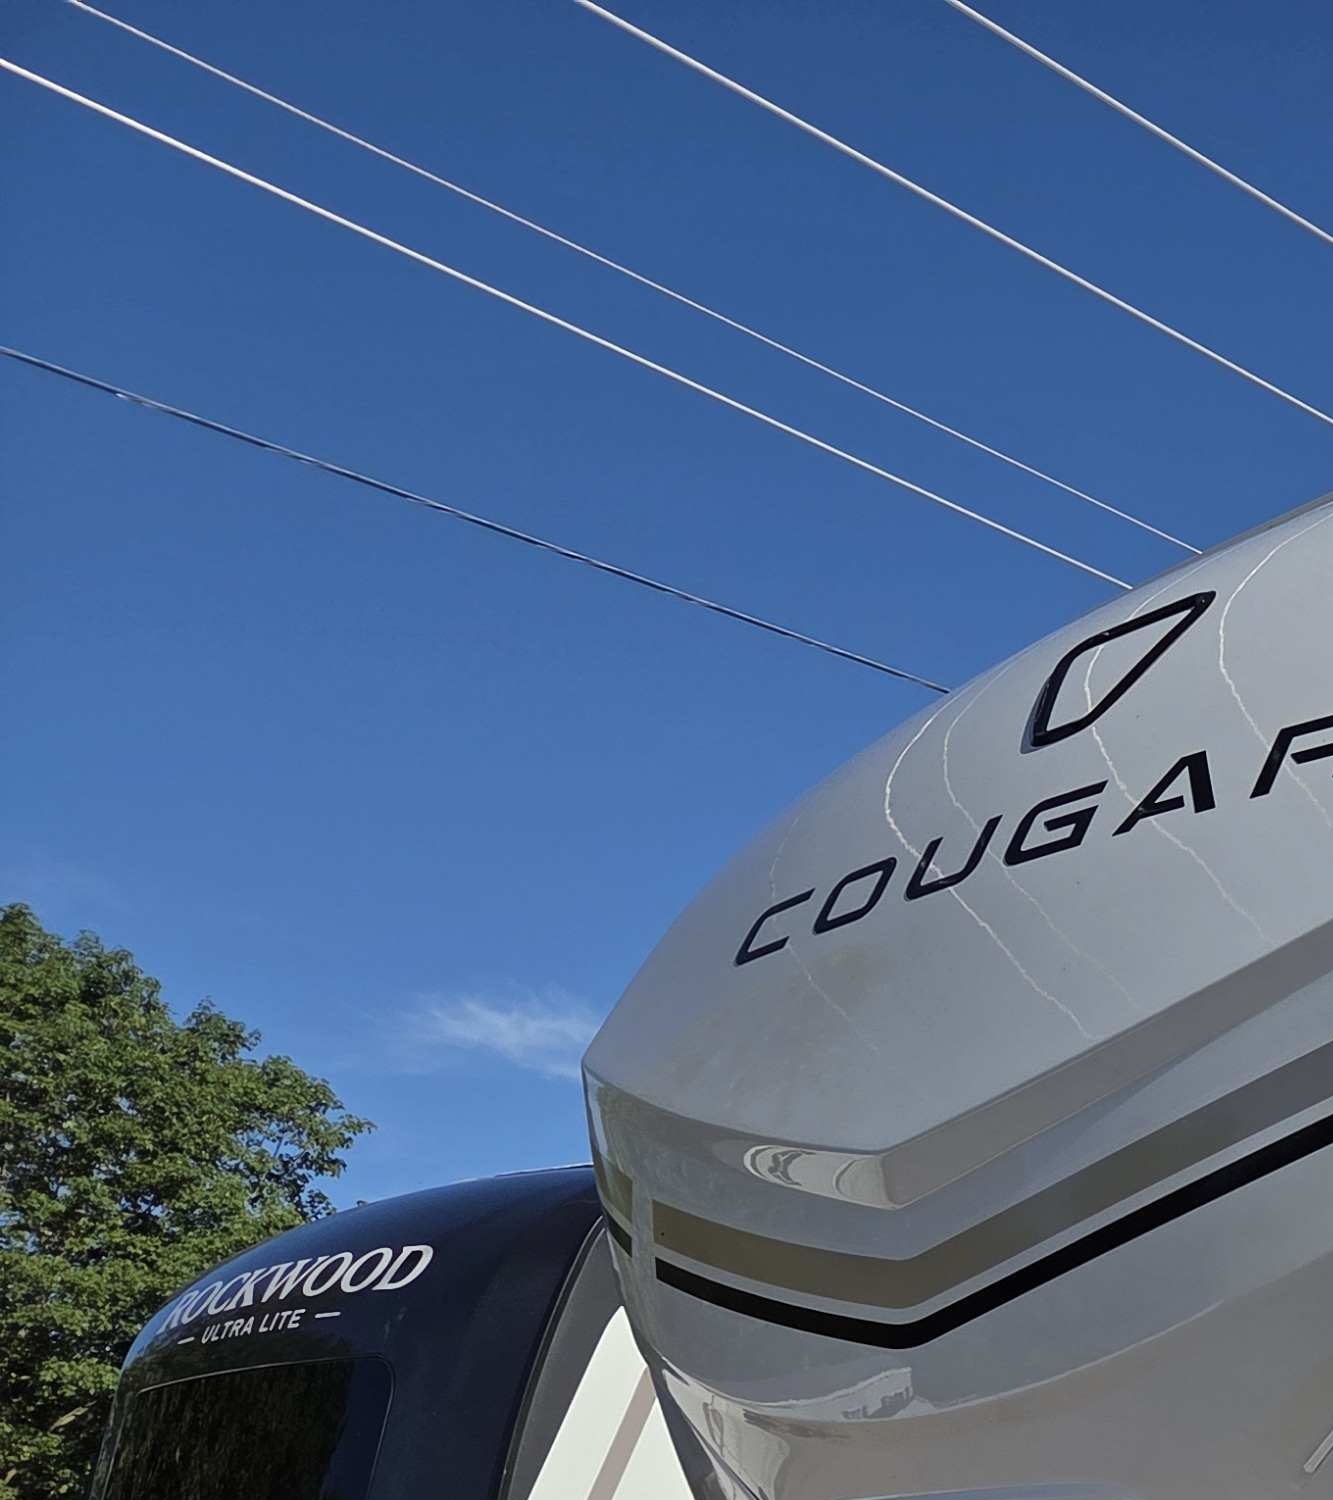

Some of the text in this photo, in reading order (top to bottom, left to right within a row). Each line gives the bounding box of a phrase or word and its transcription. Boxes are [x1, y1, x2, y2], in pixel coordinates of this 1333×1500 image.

[156, 1244, 434, 1335] ROCKWOOD
[201, 1308, 307, 1344] ULTRA LITE
